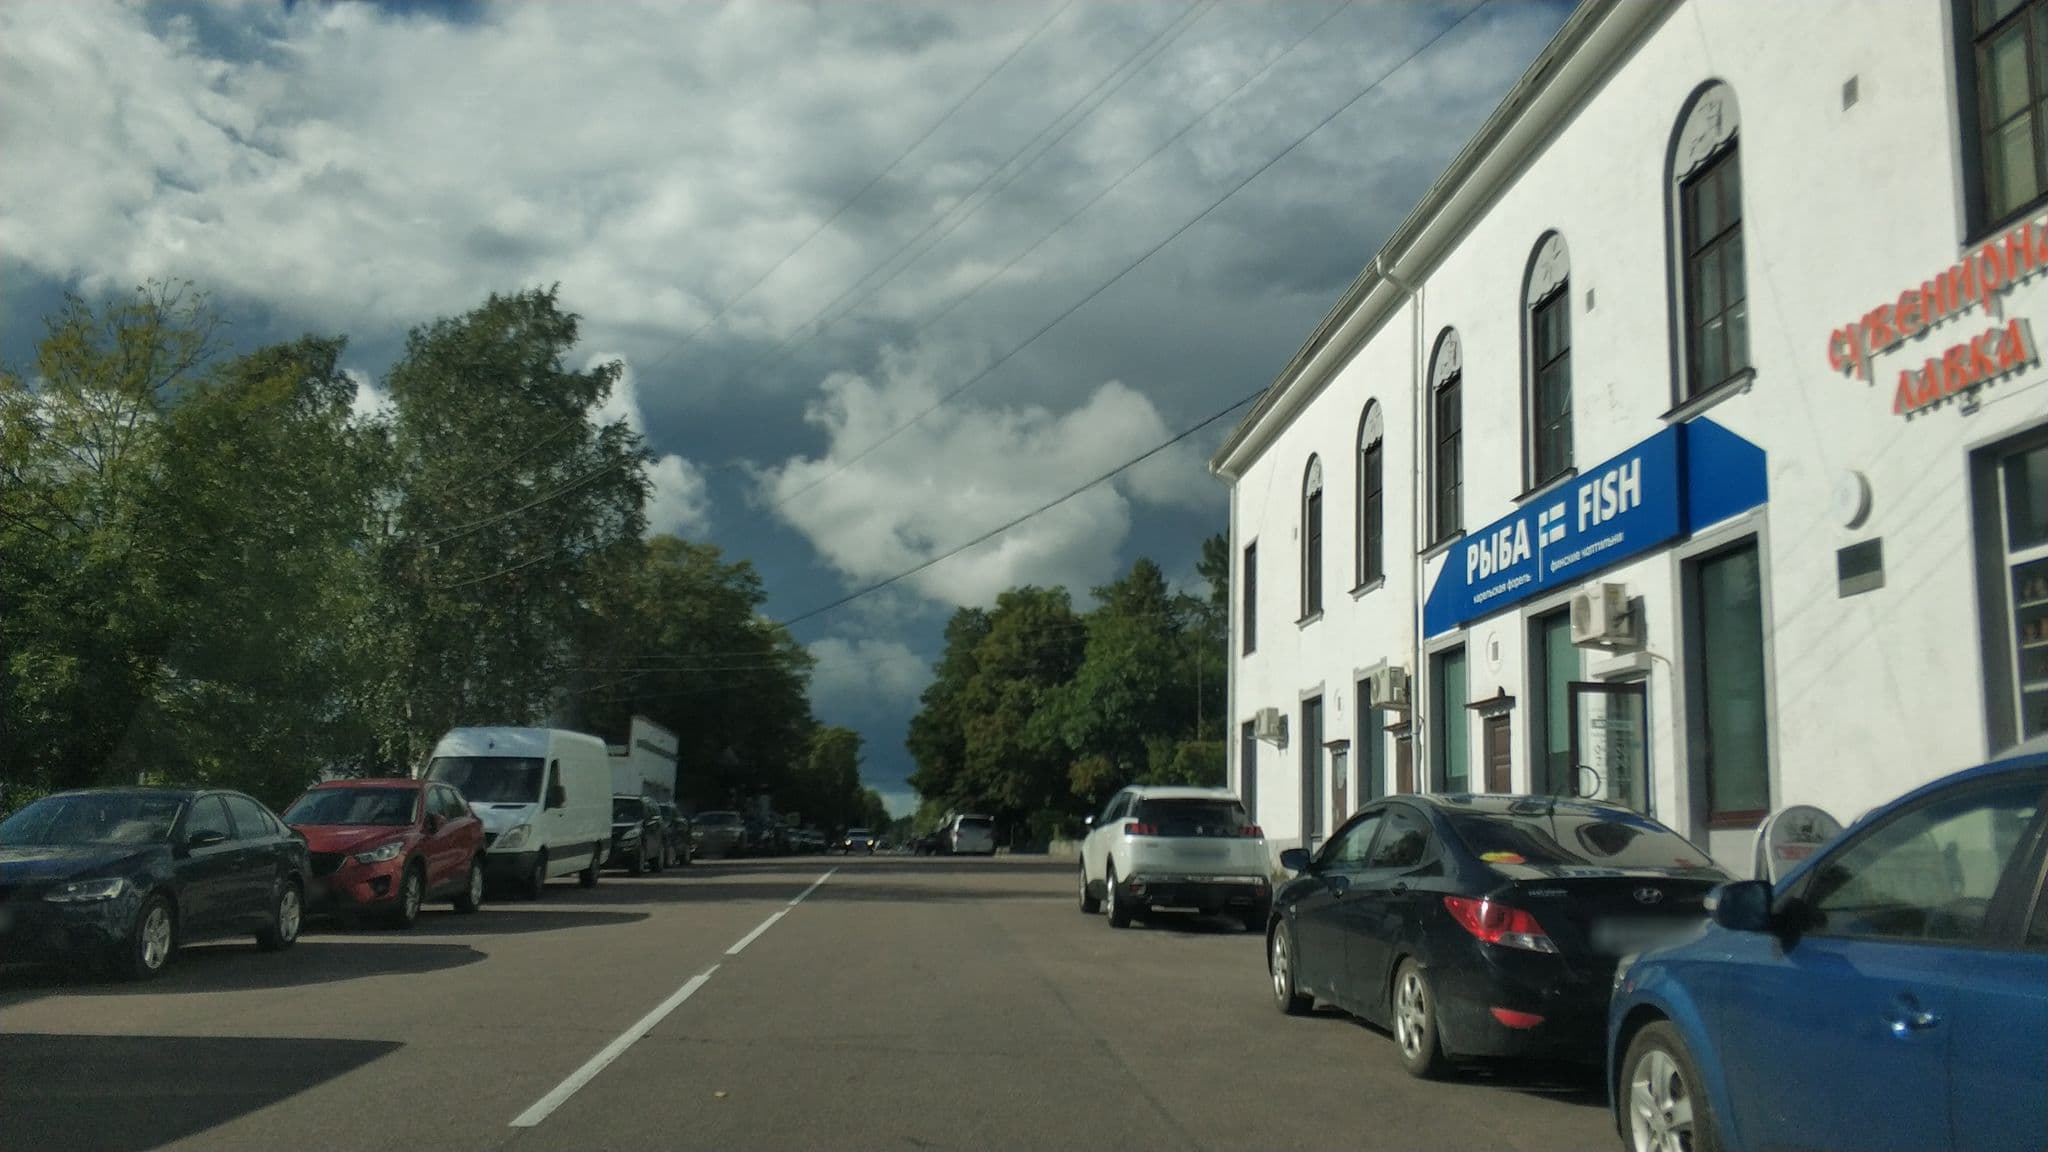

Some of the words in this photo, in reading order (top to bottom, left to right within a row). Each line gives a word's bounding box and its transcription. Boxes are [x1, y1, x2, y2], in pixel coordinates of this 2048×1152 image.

[1893, 317, 2027, 415] ЛАВКА
[1578, 457, 1641, 532] FISH
[1466, 518, 1530, 585] РЫБА
